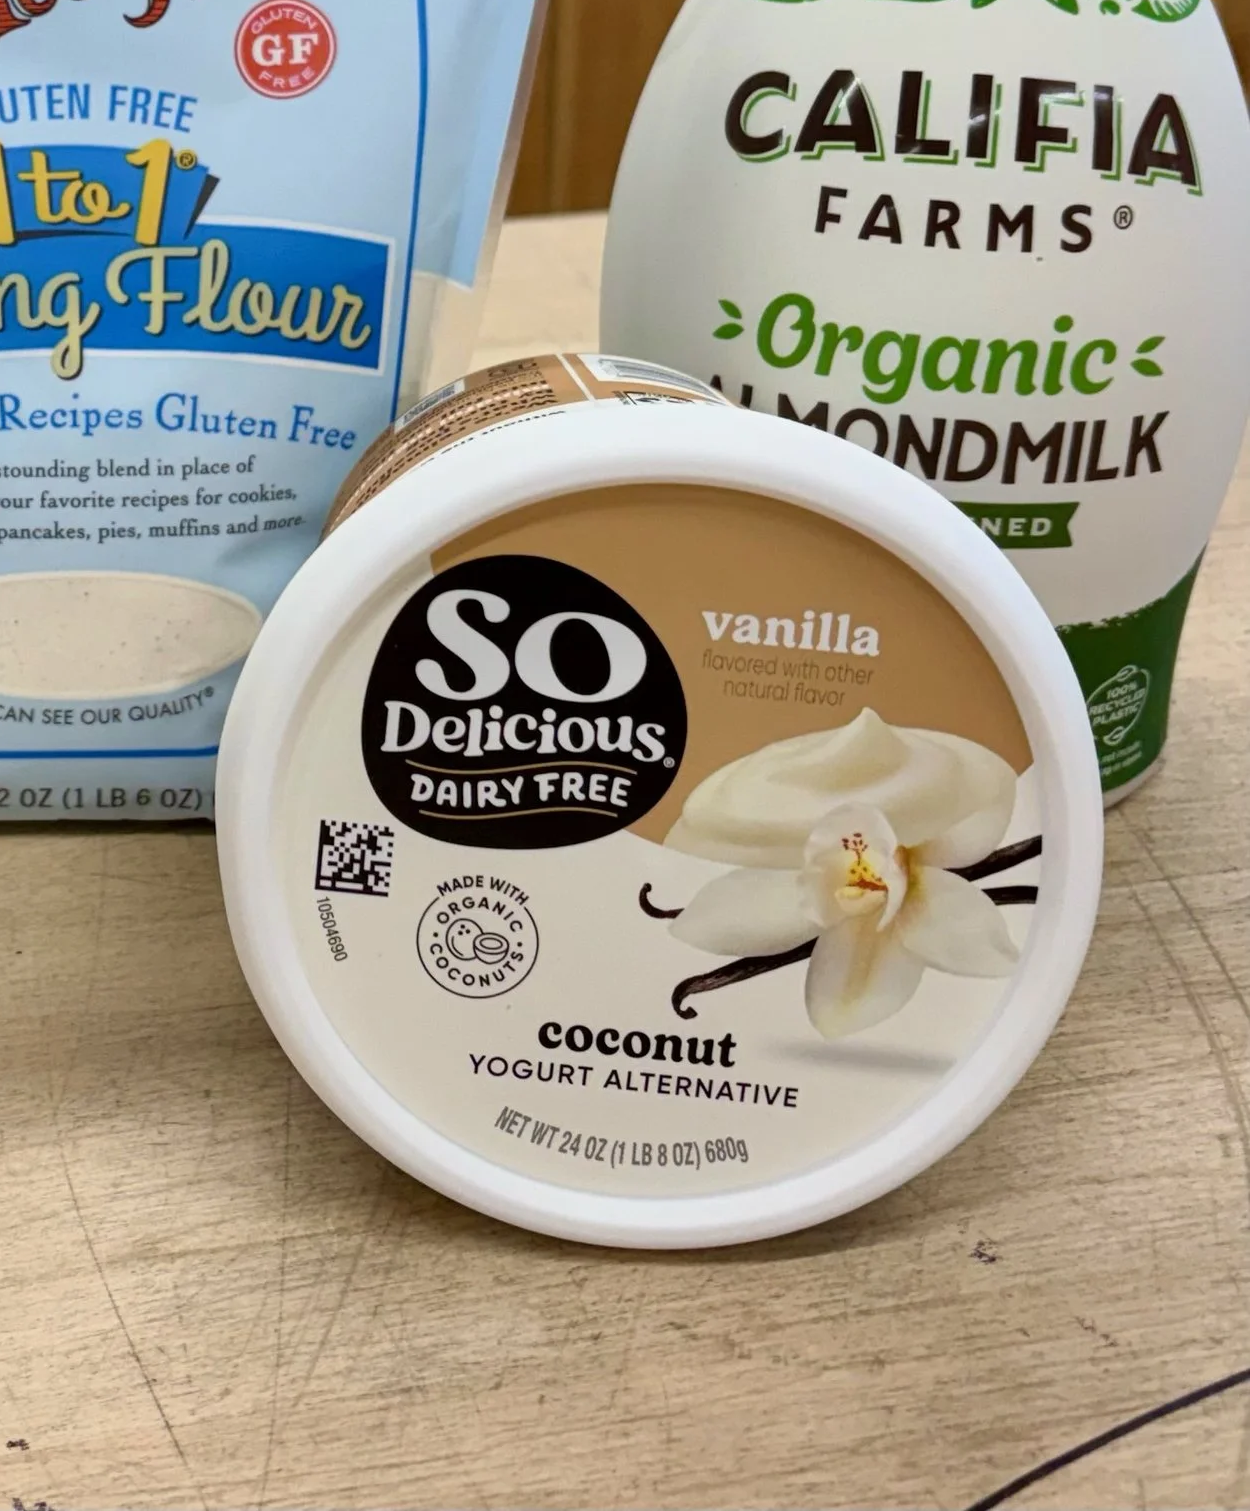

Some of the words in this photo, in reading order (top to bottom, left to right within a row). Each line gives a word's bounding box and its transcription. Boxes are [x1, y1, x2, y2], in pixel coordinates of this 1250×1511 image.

[251, 8, 318, 34] GLUTEN
[252, 33, 319, 67] GF
[258, 66, 315, 88] FREE
[108, 83, 198, 133] FREE
[723, 69, 1203, 195] CALIFIA
[17, 151, 130, 226] to
[125, 138, 173, 246] 1
[814, 185, 1094, 253] FARMS
[104, 238, 371, 350] Flour
[756, 293, 1117, 404] Organic
[156, 392, 277, 439] Gluten
[288, 404, 357, 450] Free
[97, 459, 150, 478] blend
[157, 458, 175, 477] in
[181, 457, 230, 480] place
[236, 455, 256, 473] of
[40, 489, 115, 510] favorite
[121, 490, 189, 511] recipes
[196, 487, 222, 505] for
[228, 483, 297, 504] cookies,
[98, 522, 142, 543] pies,
[149, 518, 220, 539] muffins
[226, 514, 258, 535] and
[414, 588, 648, 704] SO
[702, 609, 880, 657] vanilla
[702, 649, 777, 676] flavored
[783, 657, 819, 681] with
[824, 663, 874, 685] other
[41, 708, 74, 725] SEE
[80, 707, 122, 725] OUR
[128, 694, 206, 723] QUALITY
[723, 678, 790, 702] natural
[794, 683, 845, 706] flavor
[380, 700, 667, 764] Delicious
[20, 788, 53, 808] OZ
[62, 787, 85, 810] (1
[96, 787, 126, 808] LB
[136, 787, 151, 808] 6
[160, 787, 203, 811] OZ)
[410, 773, 524, 808] DAIRY
[533, 771, 632, 808] FREE
[436, 875, 484, 897] MADE
[490, 876, 529, 907] WITH
[436, 896, 523, 932] ORGANIC
[316, 896, 348, 962] 10504690
[429, 942, 524, 987] COCONUTS
[538, 1021, 737, 1068] coconut
[469, 1053, 593, 1086] YOGURT
[603, 1069, 798, 1108] ALTERNATIVE
[494, 1106, 532, 1138] NET
[531, 1121, 560, 1149] WT
[558, 1130, 582, 1157] 24
[584, 1137, 608, 1162] OZ
[610, 1140, 626, 1168] (1
[631, 1141, 653, 1166] LB
[657, 1142, 668, 1166] 8
[673, 1141, 700, 1170] OZ)
[705, 1137, 749, 1163] 680g
